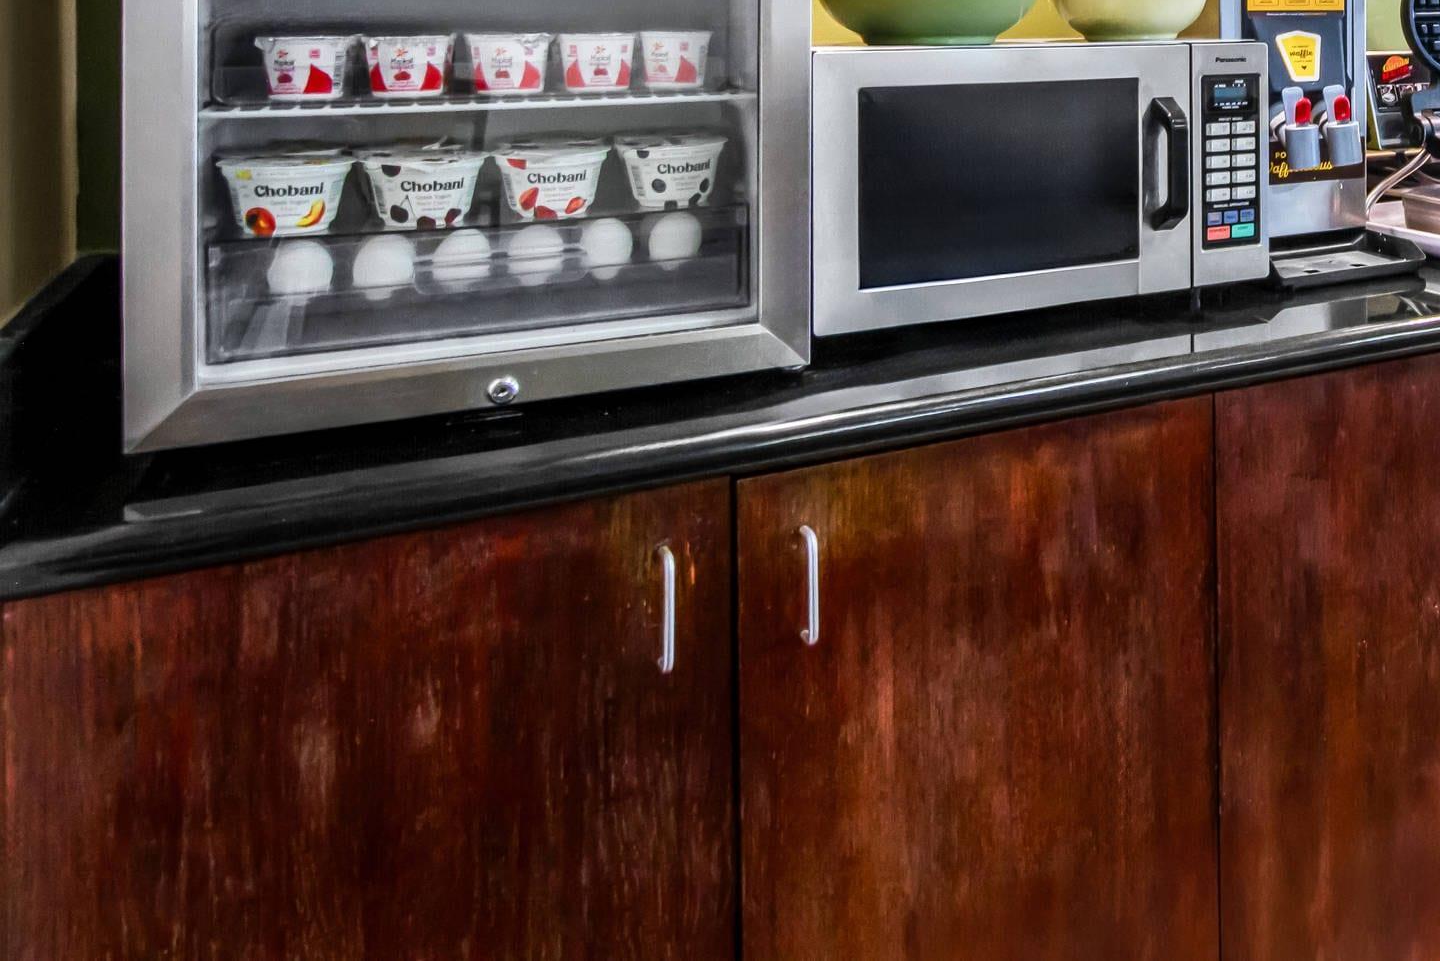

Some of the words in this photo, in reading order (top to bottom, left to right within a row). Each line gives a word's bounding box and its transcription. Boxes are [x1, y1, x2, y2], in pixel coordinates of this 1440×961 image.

[1290, 49, 1312, 58] waffle
[657, 159, 711, 175] Chobani
[401, 177, 464, 192] Chobani
[527, 170, 587, 185] Chobani
[254, 182, 325, 197] Chobani
